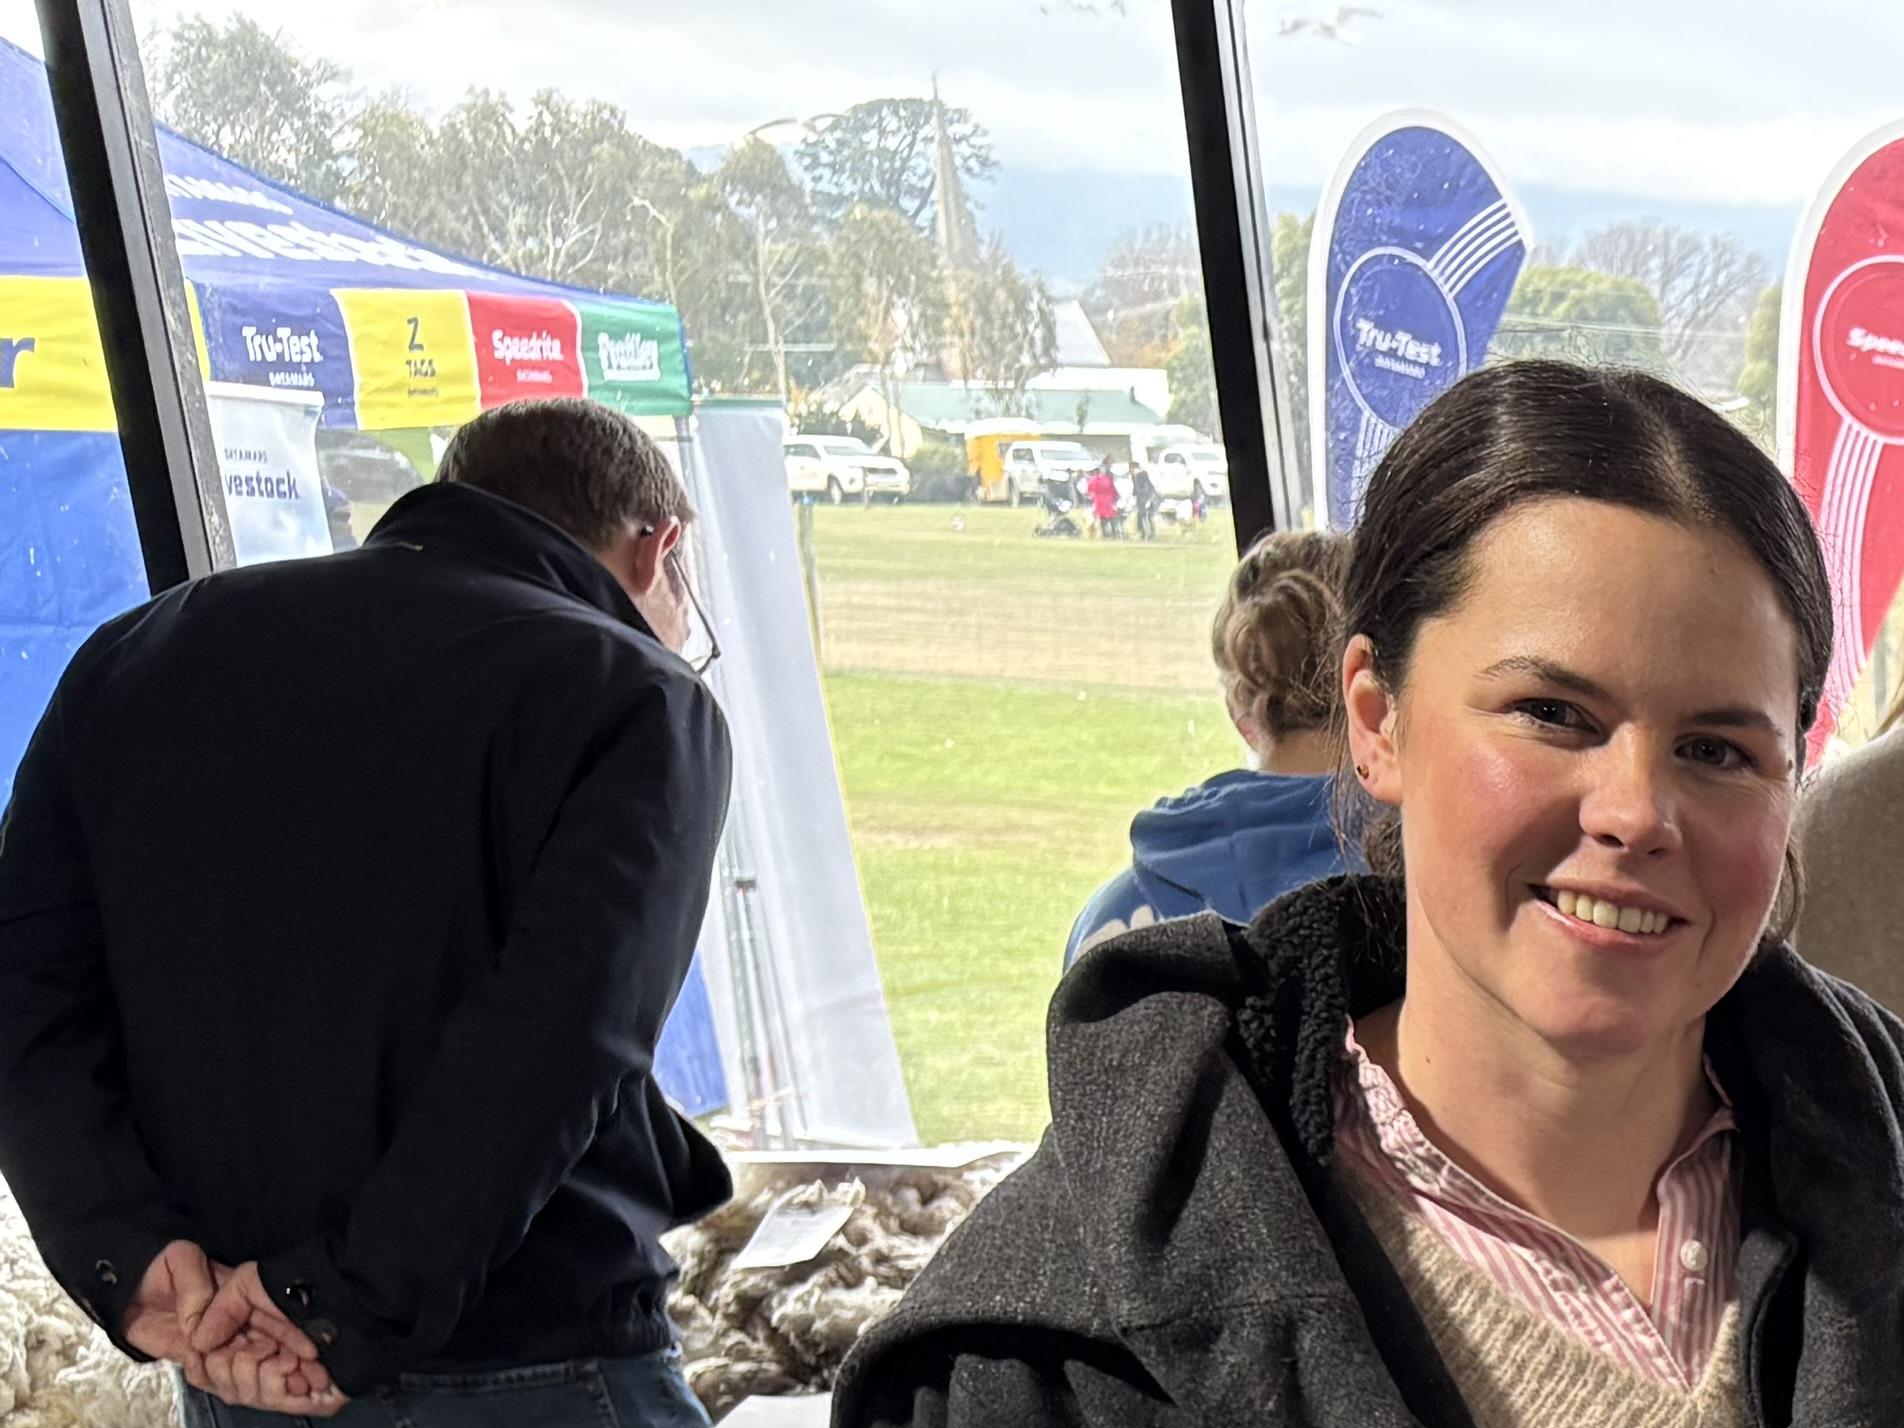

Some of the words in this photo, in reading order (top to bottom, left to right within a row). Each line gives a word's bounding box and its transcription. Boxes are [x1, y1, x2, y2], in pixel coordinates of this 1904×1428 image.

[242, 326, 322, 363] Tru-Test
[407, 318, 424, 352] Z
[491, 330, 564, 365] Speedrite
[1356, 319, 1441, 366] Tru-Test
